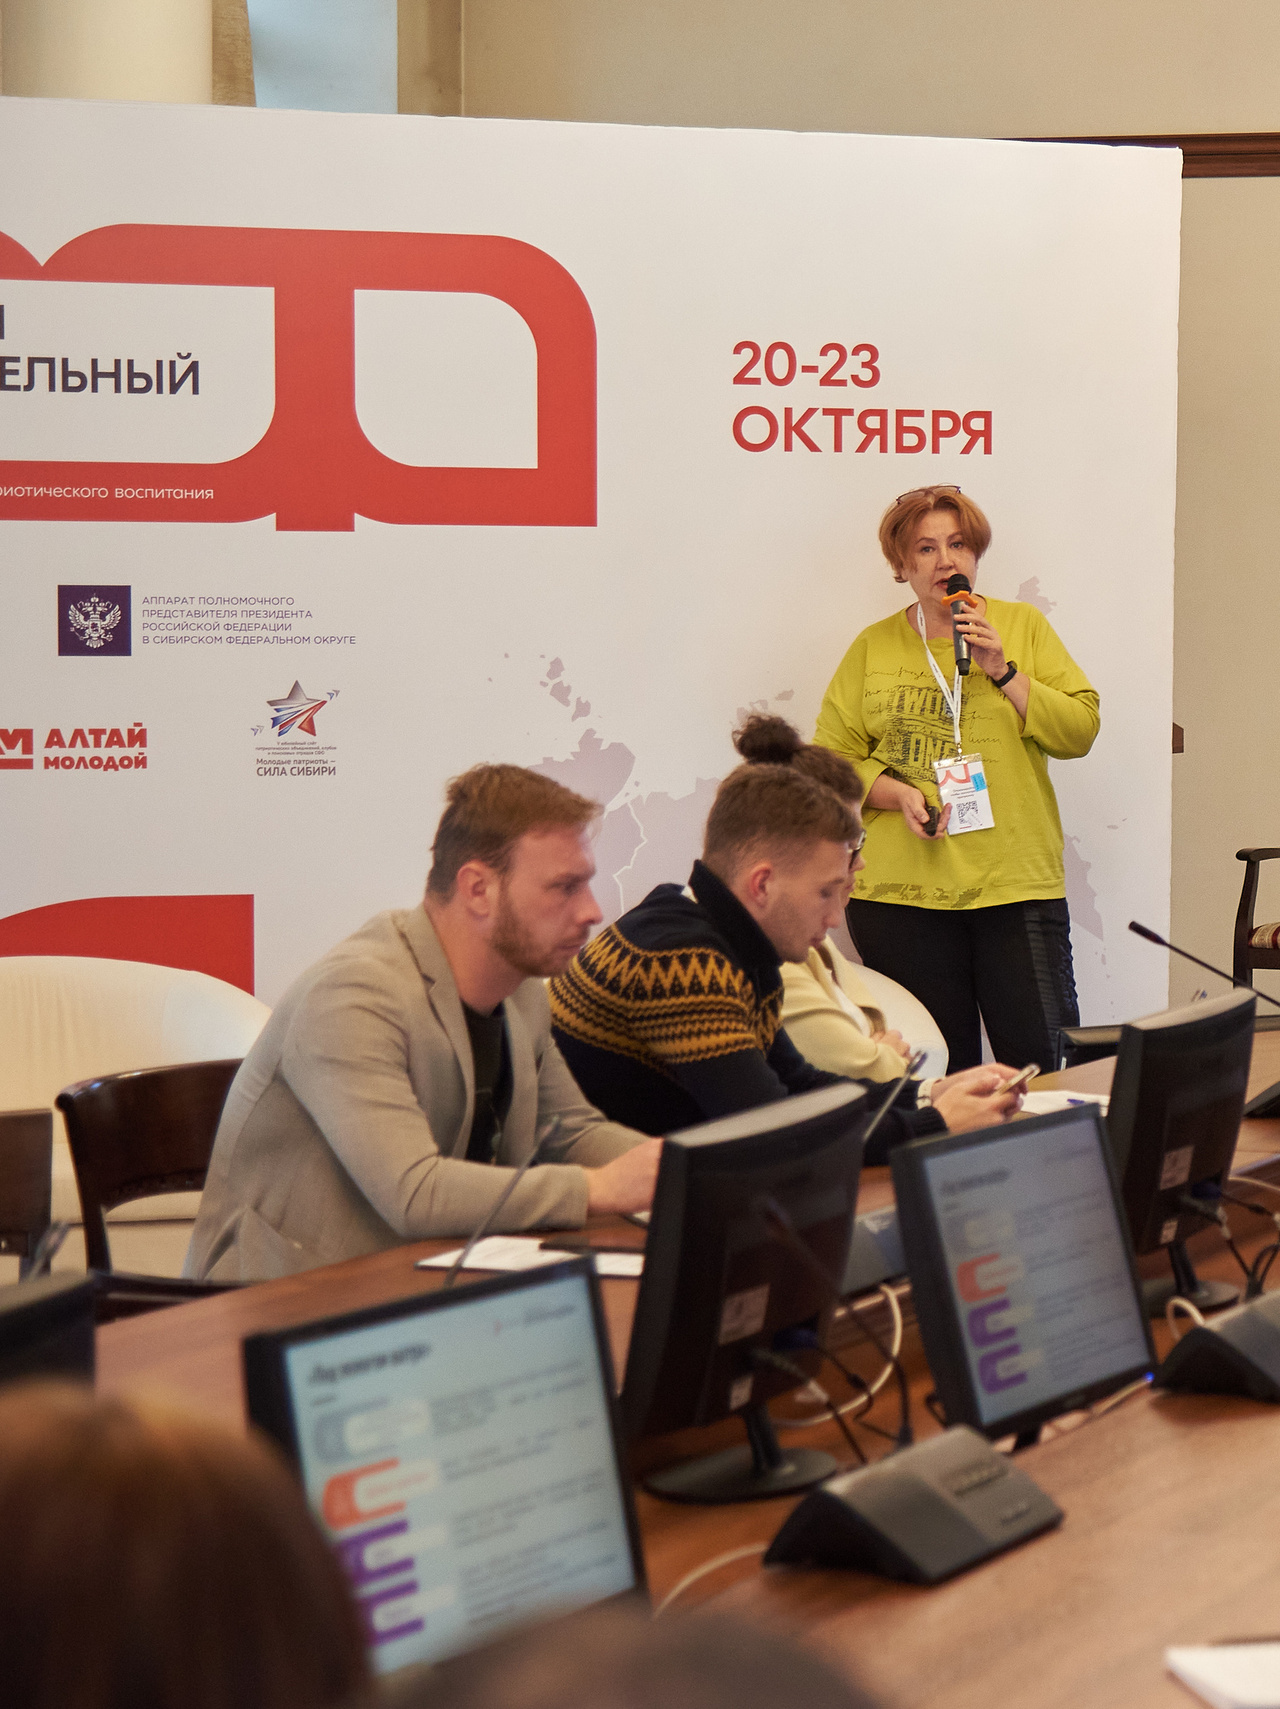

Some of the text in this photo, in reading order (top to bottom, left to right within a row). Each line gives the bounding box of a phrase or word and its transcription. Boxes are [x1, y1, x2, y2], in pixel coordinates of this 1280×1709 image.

[732, 340, 881, 389] 20-23
[0, 352, 199, 395] ЕЛЬНЫЙ
[732, 405, 993, 455] ОКТЯБРЯ
[114, 487, 214, 499] воспитания
[142, 596, 295, 606] АППАРАТ ПОЛНОМОЧНОГО
[142, 609, 313, 619] ПРЕДСТАВИТЕЛЯ ПРЕЗИДЕНТА
[142, 621, 292, 632] РОССИЙСКОЙ ФЕДЕРАЦИИ
[142, 635, 356, 645] В СИБИРСКОМ ФЕДЕРАЛЬНОМ ОКРУГЕ
[44, 722, 147, 748] АЛТАЙ
[44, 752, 147, 772] МОЛОДОЙ
[256, 766, 336, 776] СИЛА СИБИРИ
